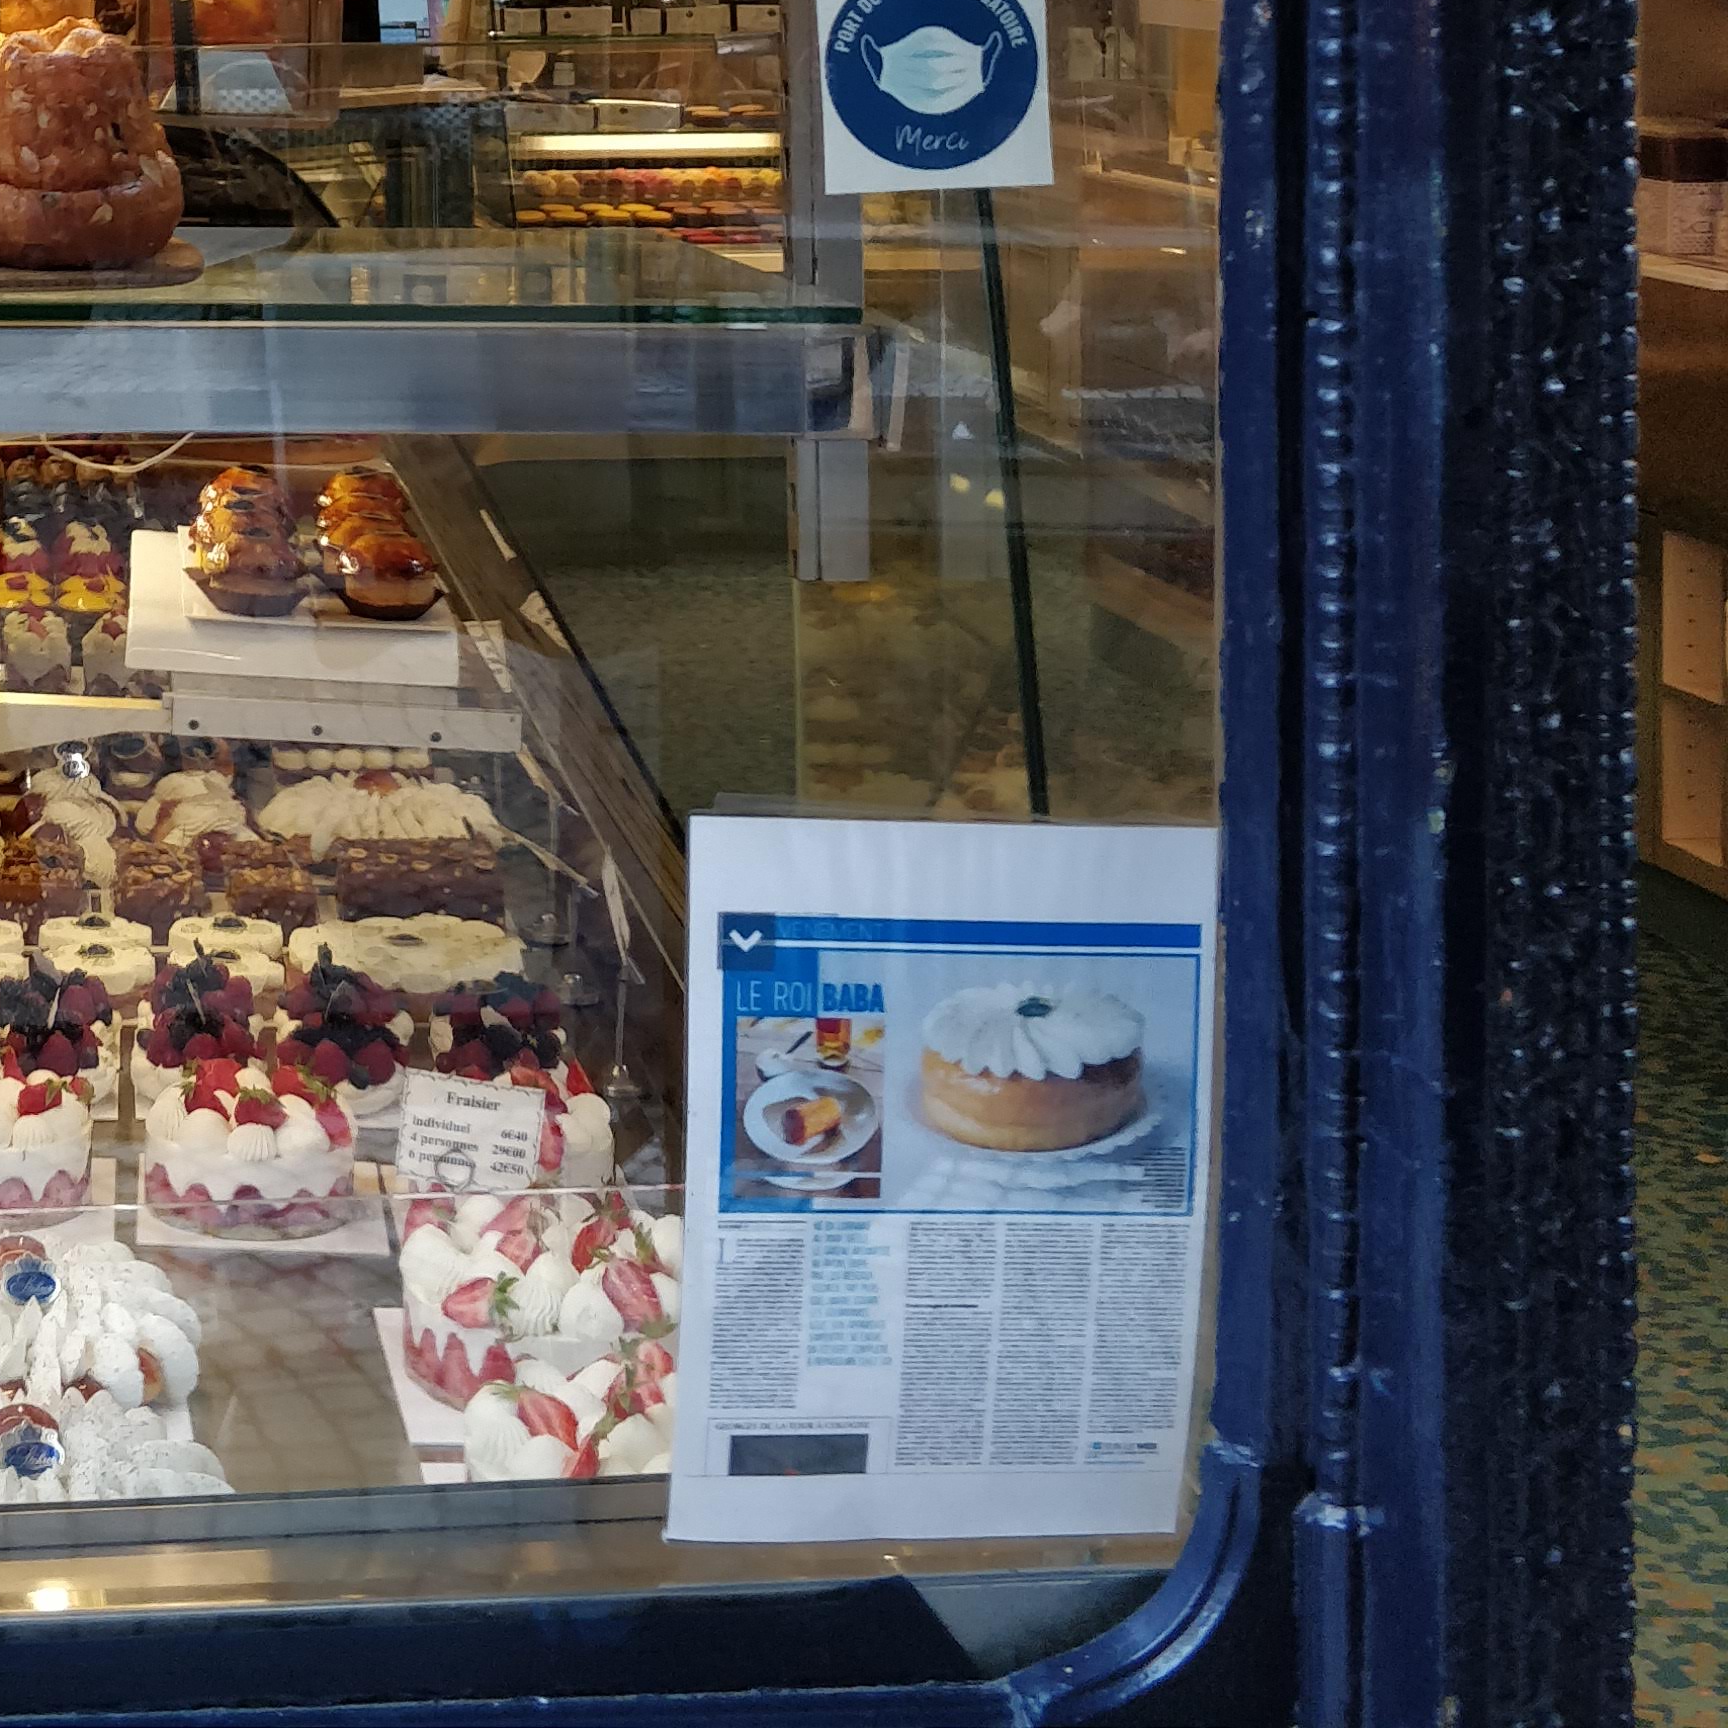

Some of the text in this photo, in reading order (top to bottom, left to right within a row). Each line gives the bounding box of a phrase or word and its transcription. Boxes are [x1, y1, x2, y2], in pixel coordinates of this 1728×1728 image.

[834, 11, 864, 53] PORT
[895, 124, 970, 155] Merci
[736, 980, 885, 1013] LE ROI BABA
[446, 1091, 501, 1112] Fraisier
[412, 1116, 471, 1134] individuel
[410, 1133, 418, 1142] 4
[421, 1134, 479, 1153] personnes
